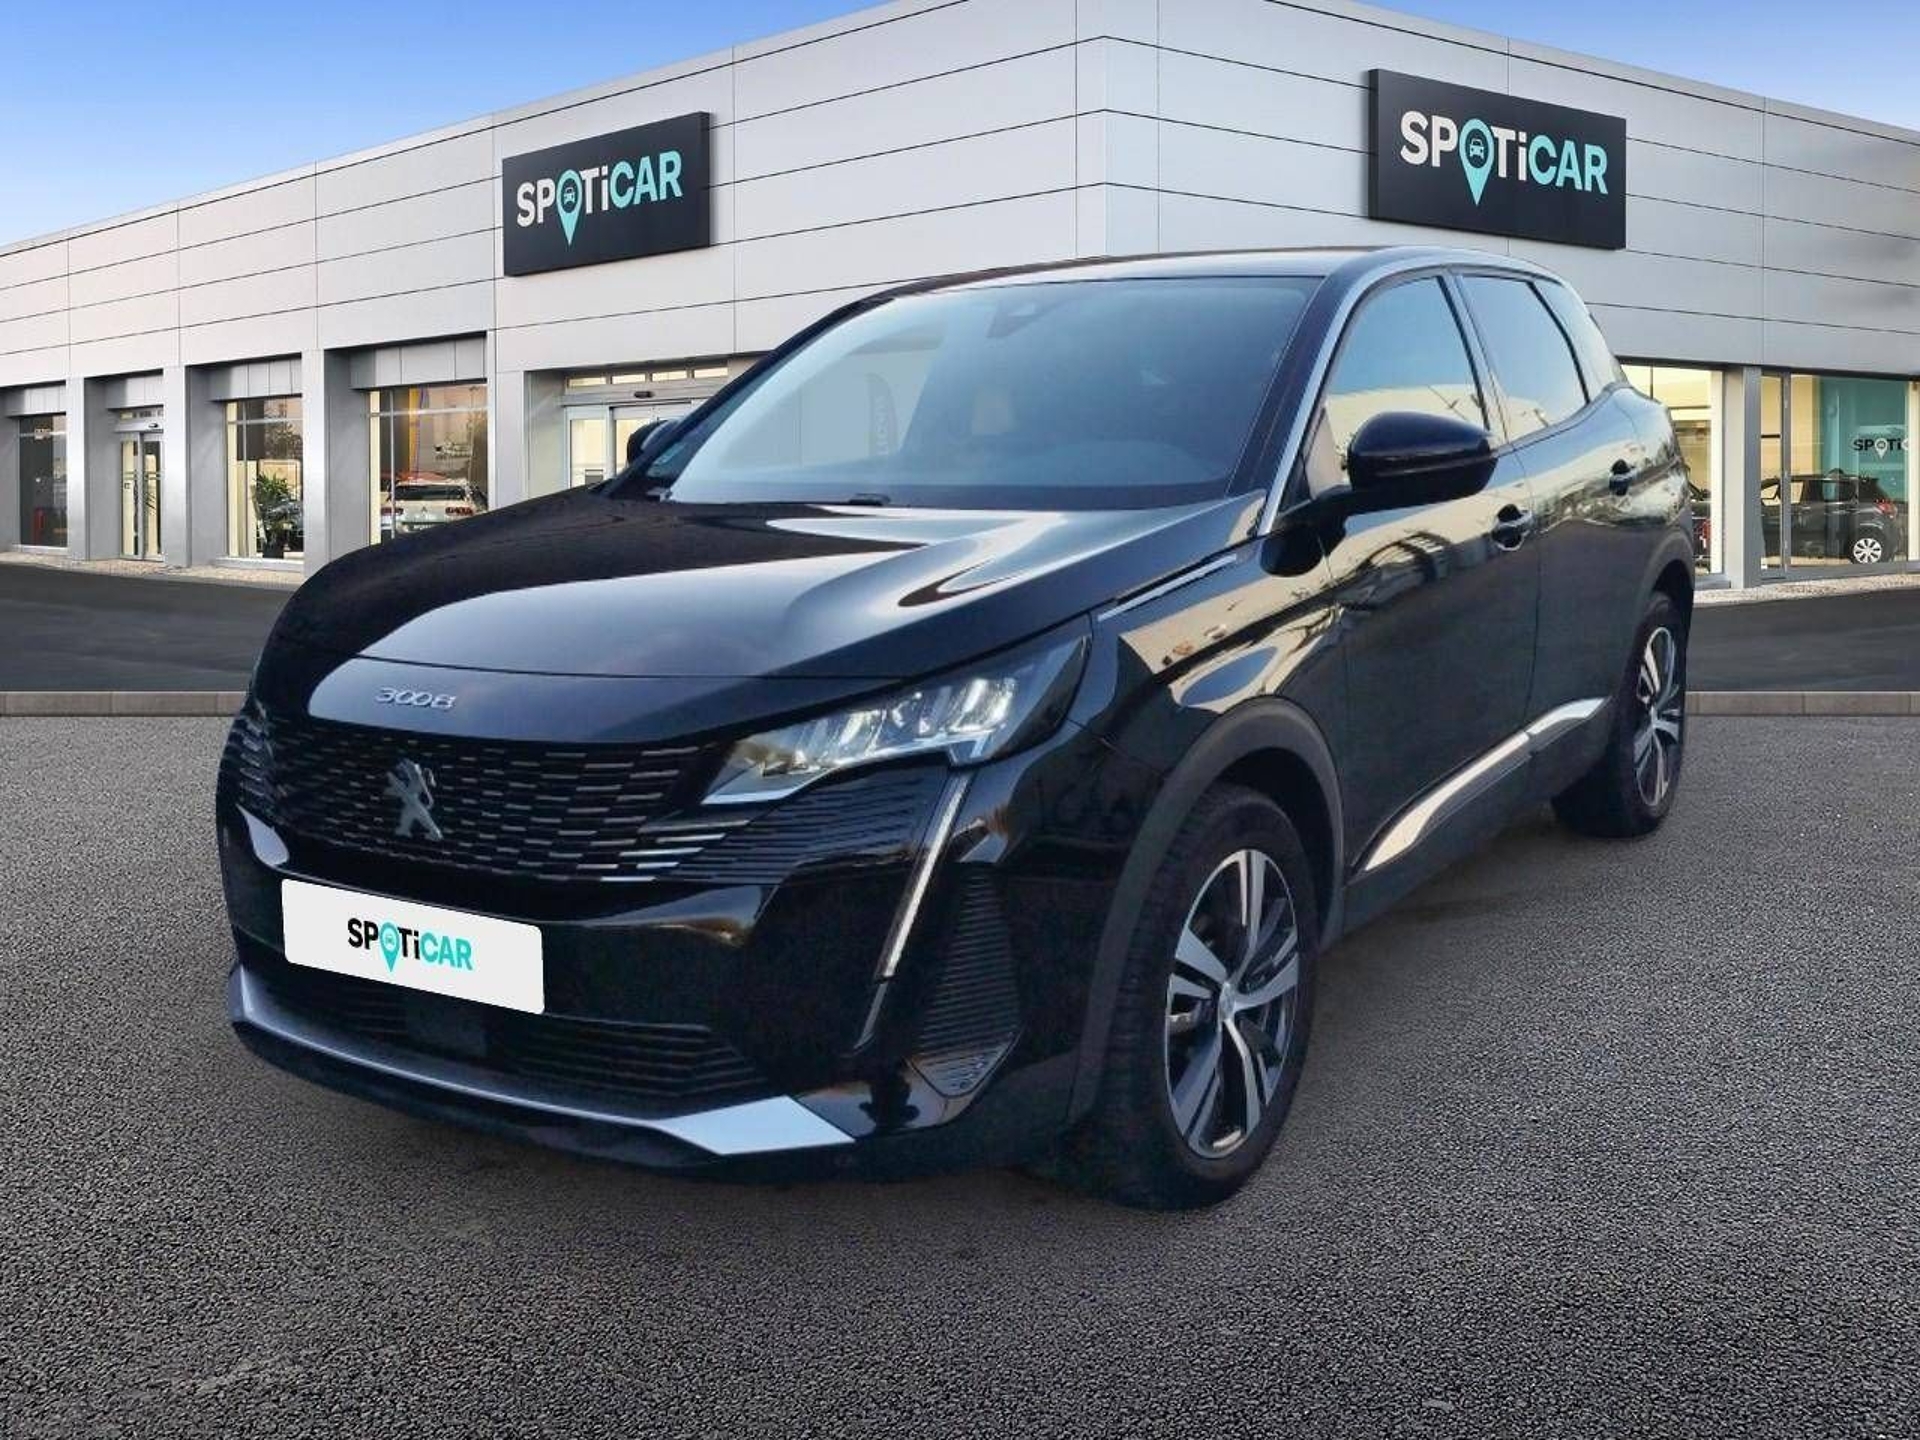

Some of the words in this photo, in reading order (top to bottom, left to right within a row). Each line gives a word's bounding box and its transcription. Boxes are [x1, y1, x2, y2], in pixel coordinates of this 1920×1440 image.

[1400, 110, 1609, 206] SPOTiCAR
[516, 150, 684, 247] SPOTiCAR
[375, 687, 456, 709] 3008
[347, 917, 473, 973] SPOTiCAR
